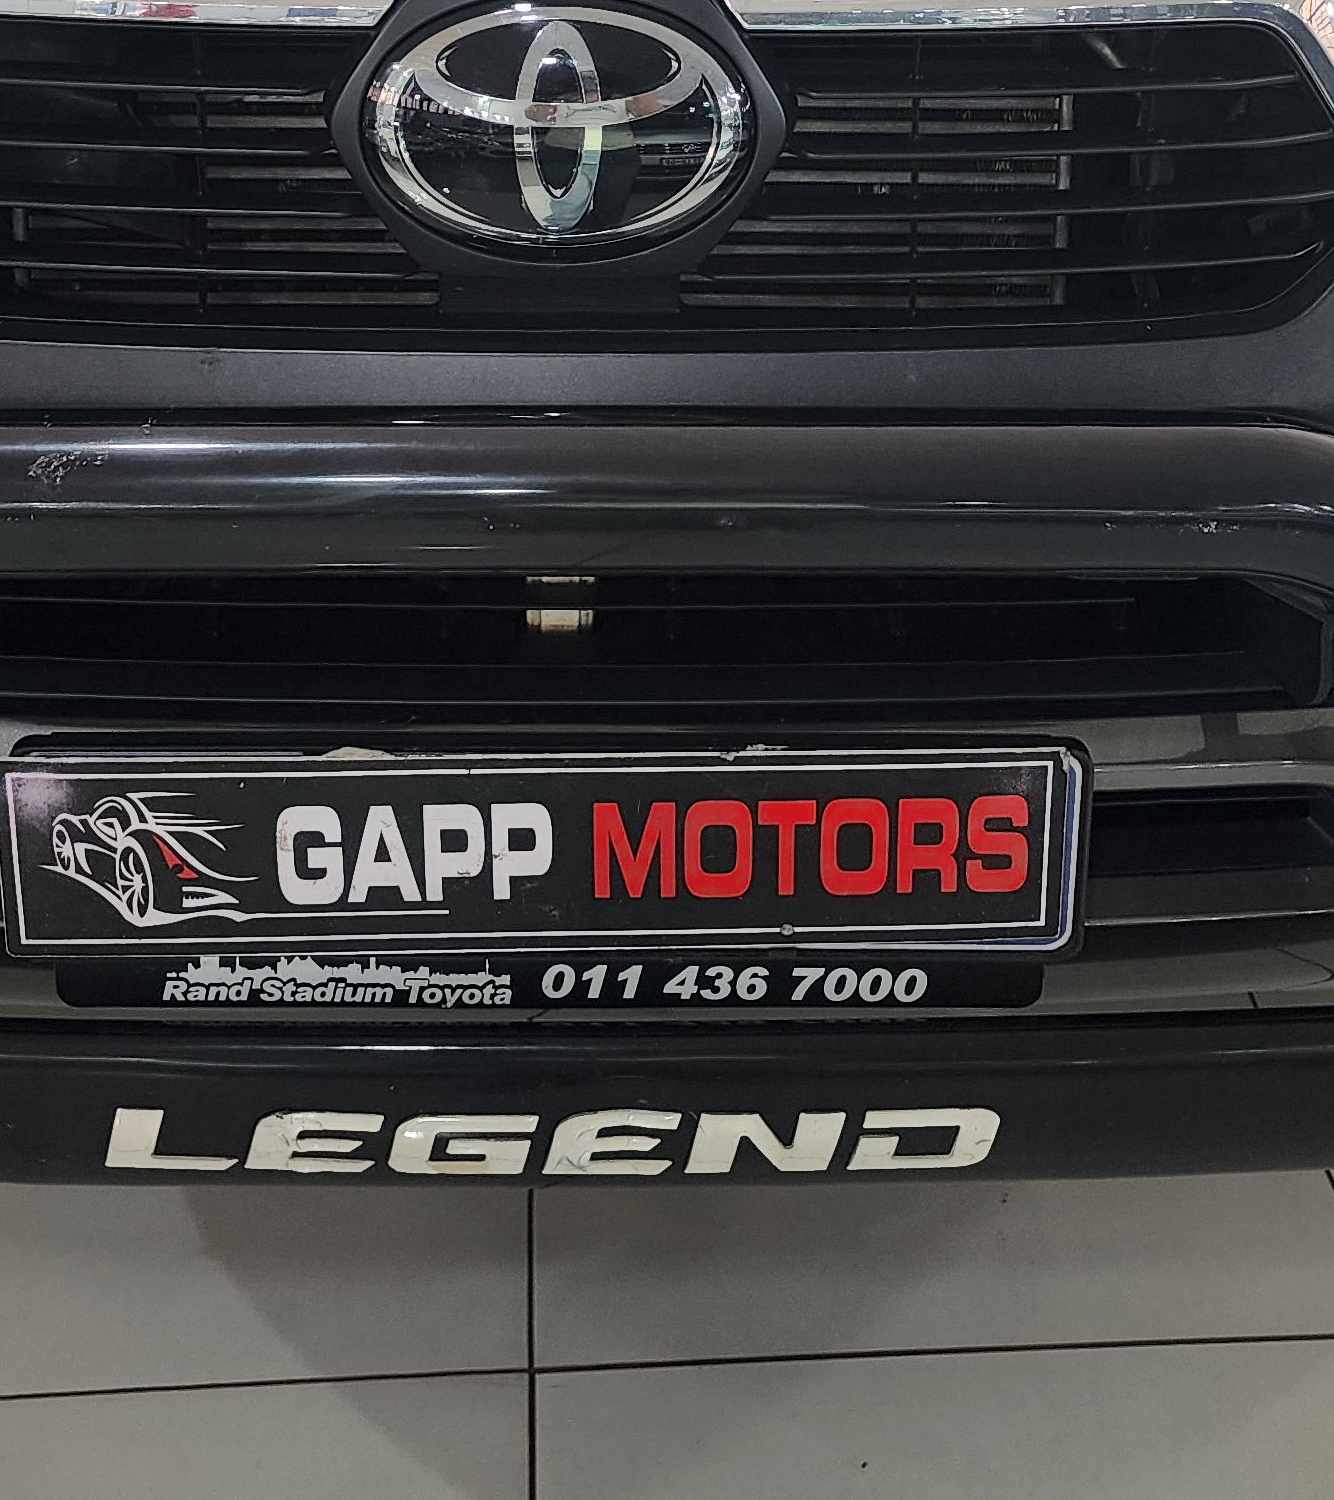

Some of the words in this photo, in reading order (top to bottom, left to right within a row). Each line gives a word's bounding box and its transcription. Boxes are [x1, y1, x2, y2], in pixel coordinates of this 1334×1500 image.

[275, 802, 553, 906] GAPP
[593, 795, 1029, 899] MOTORS
[163, 980, 251, 1001] Rand
[260, 980, 393, 1004] Stadium
[405, 980, 512, 1008] Toyota
[541, 964, 643, 999] 011
[663, 965, 769, 1000] 436
[791, 967, 928, 1002] 7000
[104, 1107, 1002, 1177] LEGEND
